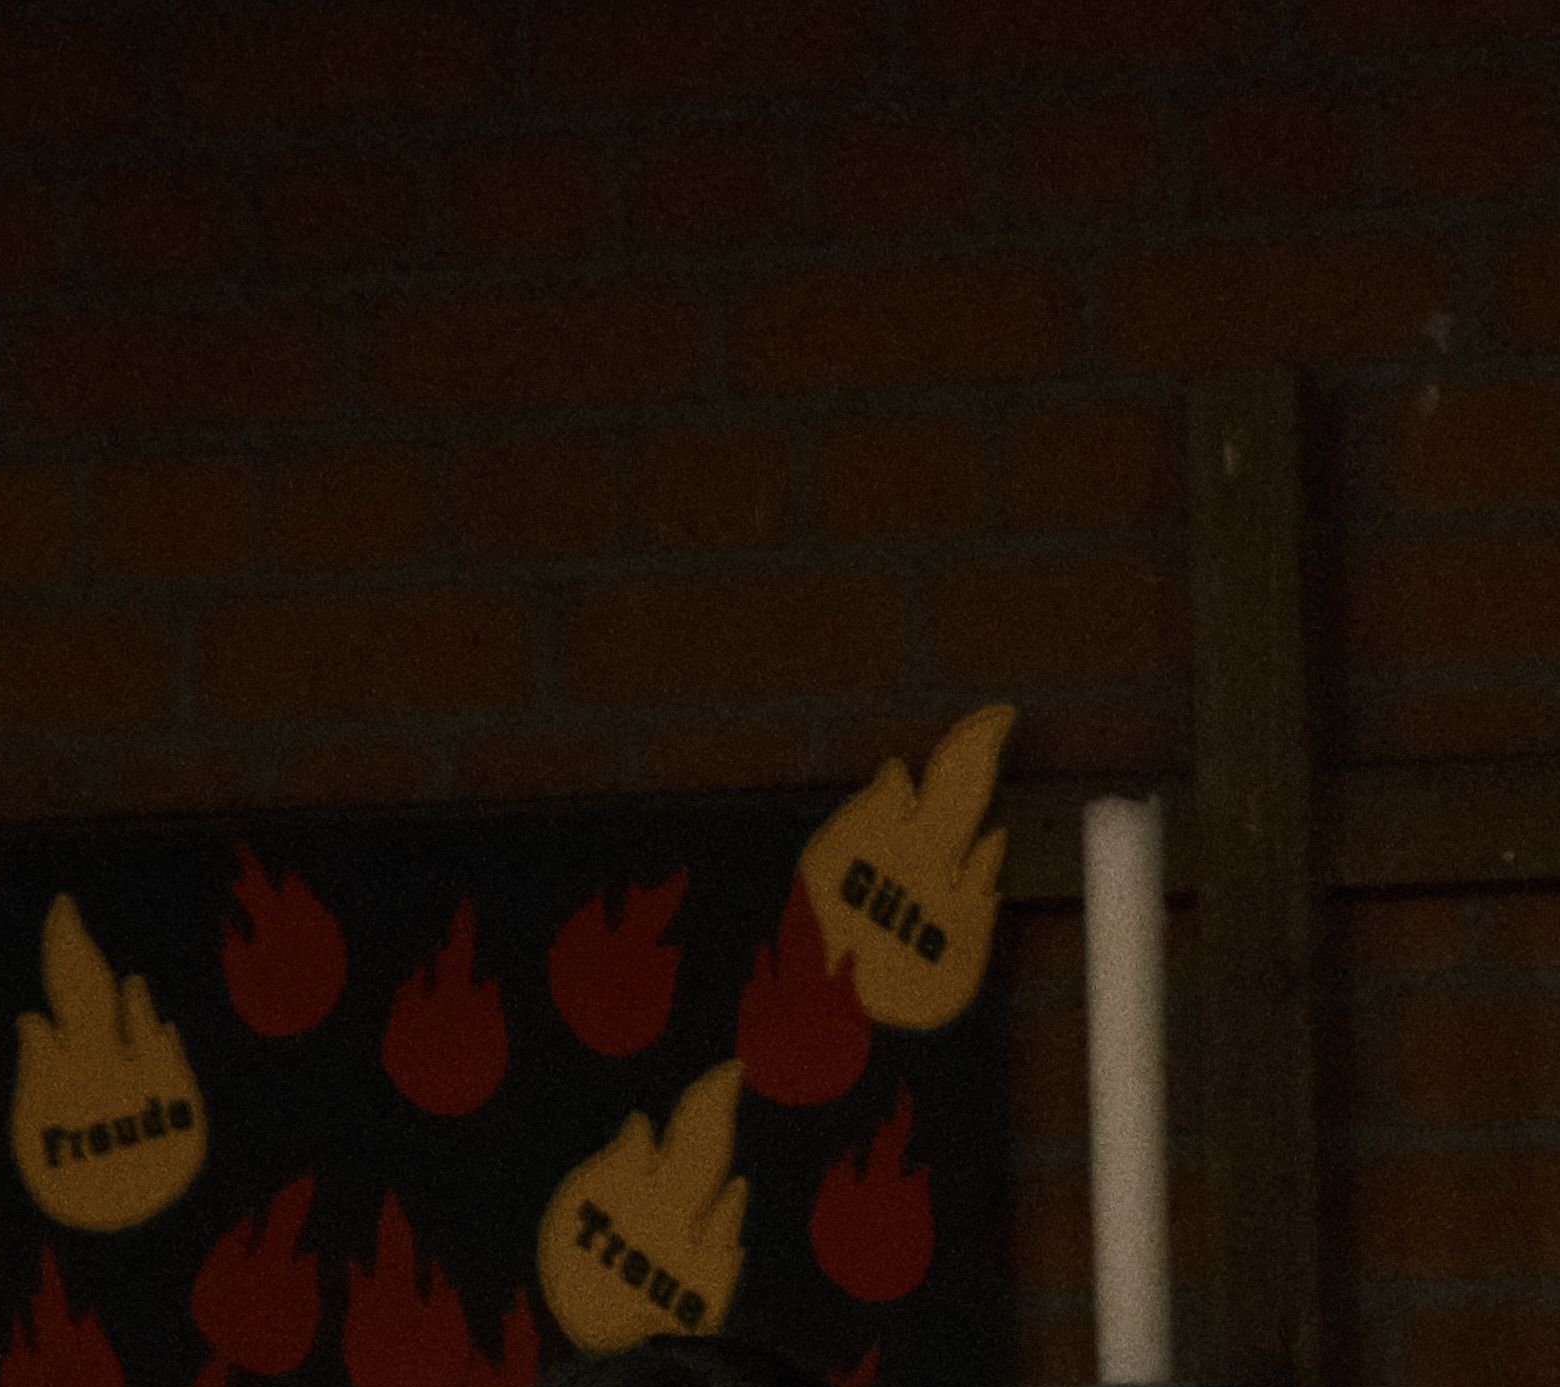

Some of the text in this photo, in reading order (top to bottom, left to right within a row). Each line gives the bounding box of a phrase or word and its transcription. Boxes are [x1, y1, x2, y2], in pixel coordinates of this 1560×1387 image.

[842, 857, 947, 962] Güte
[42, 1095, 192, 1169] Freude
[577, 1199, 707, 1329] Treue
